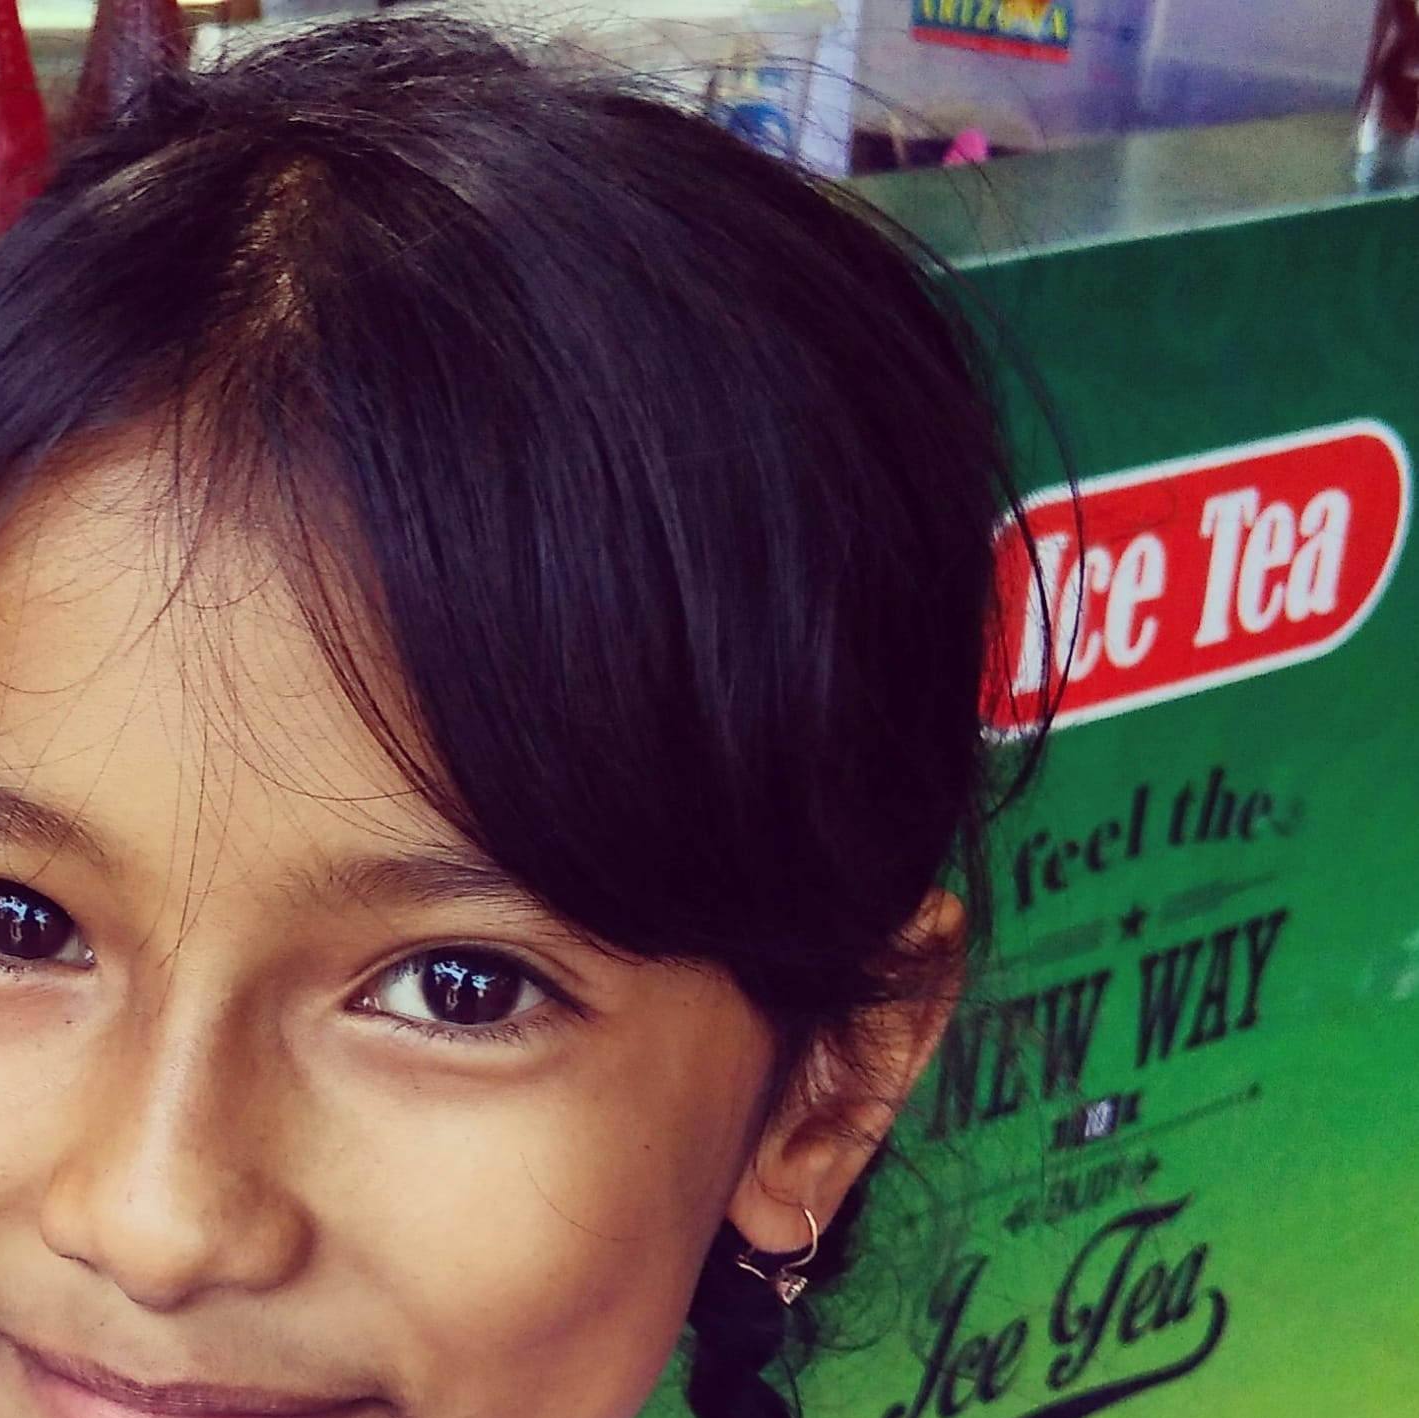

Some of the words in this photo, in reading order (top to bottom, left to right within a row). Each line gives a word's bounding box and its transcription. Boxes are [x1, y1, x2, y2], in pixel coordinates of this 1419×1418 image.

[1012, 530, 1167, 697] Ice
[1194, 486, 1351, 648] Tea
[1013, 783, 1150, 912] feel
[1167, 764, 1274, 846] the
[926, 969, 1112, 1141] NEW
[1135, 907, 1290, 1068] WAY
[1045, 1193, 1209, 1390] Tea
